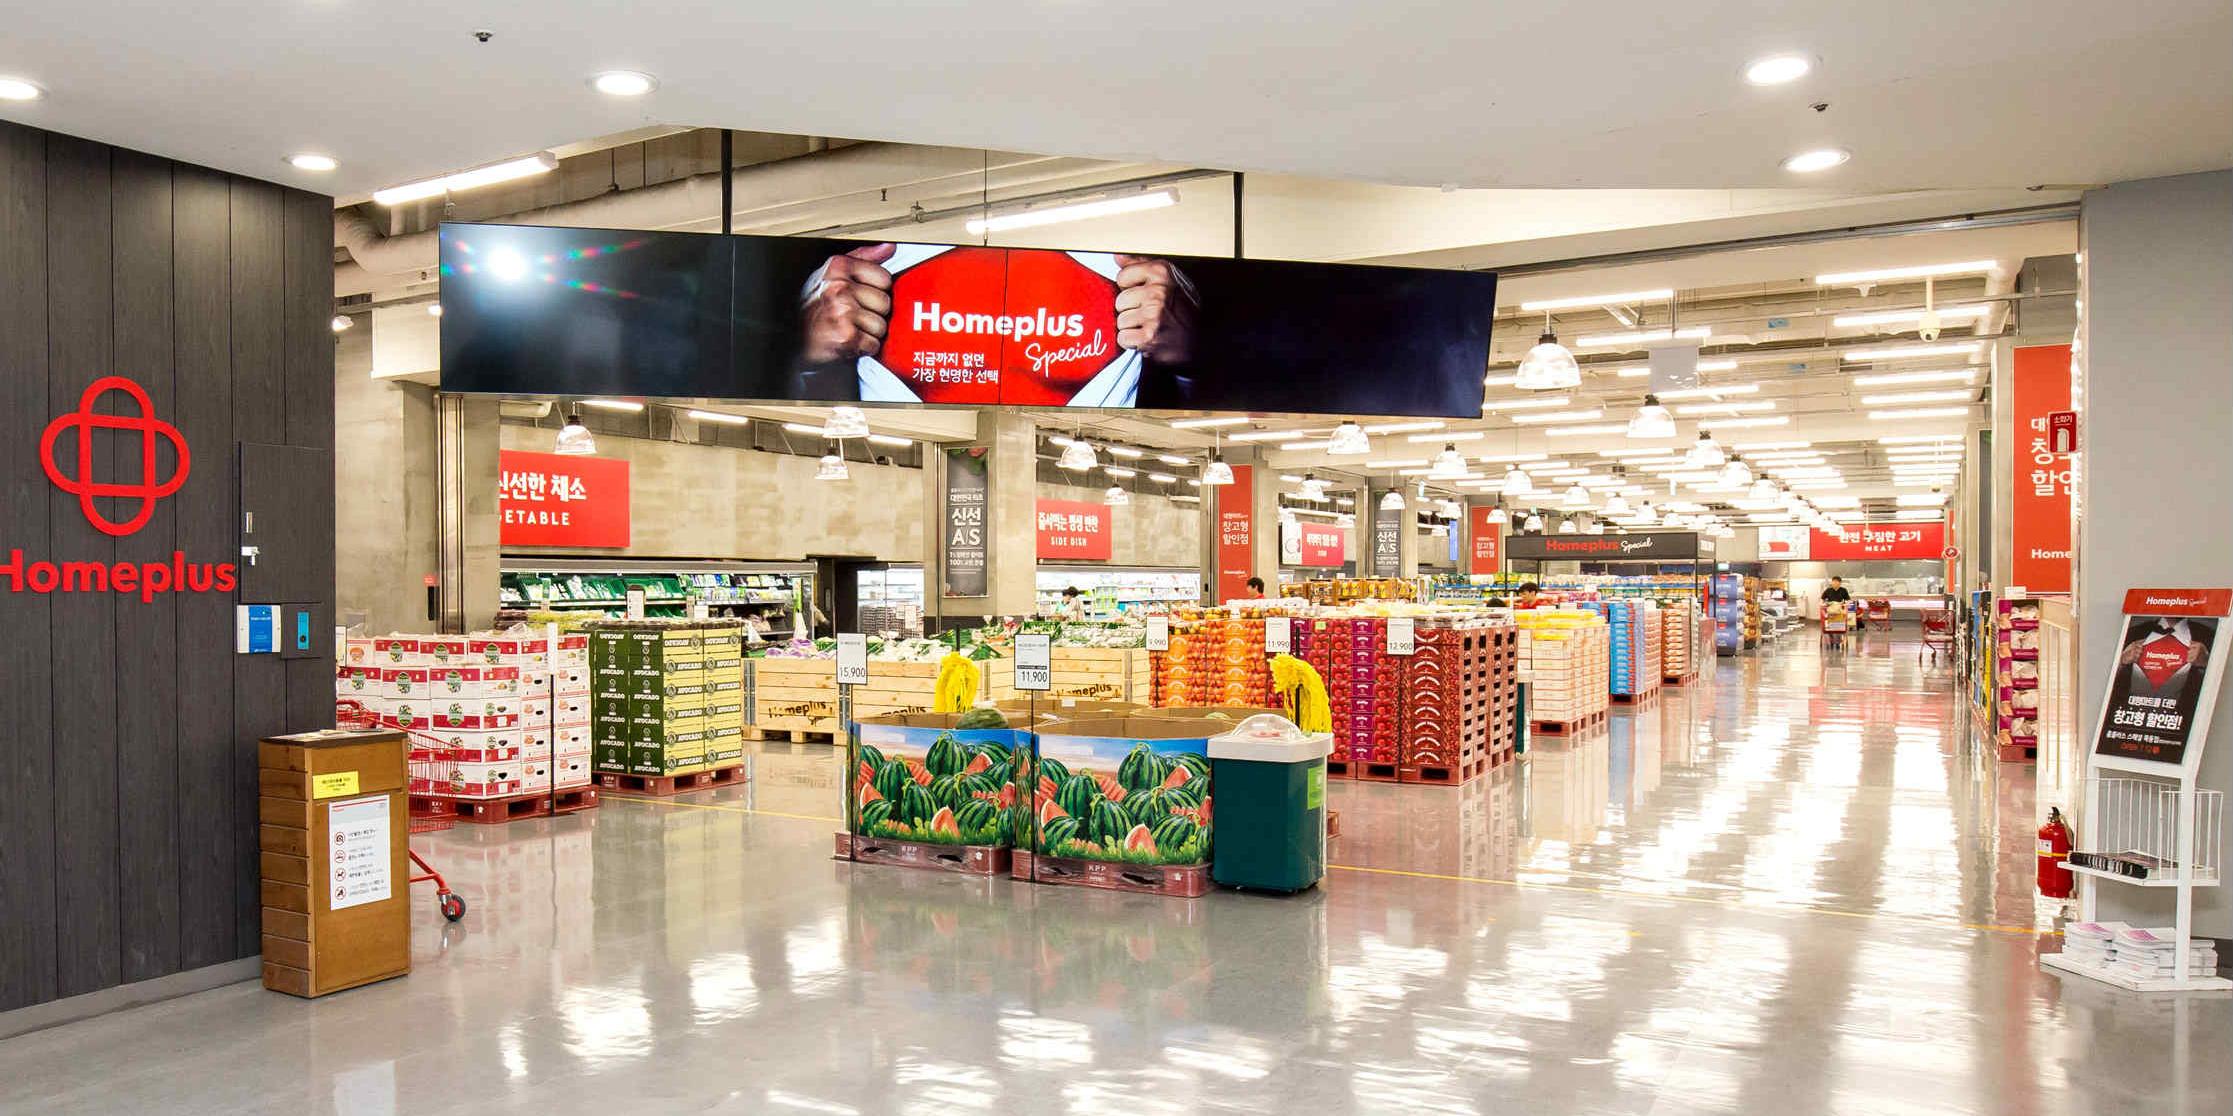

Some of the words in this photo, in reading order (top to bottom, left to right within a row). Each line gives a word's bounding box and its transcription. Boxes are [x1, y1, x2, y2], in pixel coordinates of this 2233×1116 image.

[913, 302, 1083, 342] Homeplus
[912, 351, 959, 367] 지금까지
[1026, 331, 1106, 375] Special
[912, 367, 936, 383] 가장
[938, 368, 973, 384] 현명한
[975, 370, 999, 384] 선택
[2030, 415, 2049, 432] 대
[498, 470, 546, 501] 신선한
[551, 474, 587, 502] 채소
[499, 509, 571, 526] ETABLE
[951, 506, 982, 527] 신선
[1223, 520, 1249, 533] 창고형
[951, 528, 982, 547] A/S
[1050, 536, 1067, 546] SIDE
[1070, 537, 1087, 547] DISH
[1222, 533, 1249, 546] 할인점
[1377, 531, 1397, 543] 신선
[1898, 529, 1921, 542] 고기
[1545, 538, 1620, 553] Homeplus
[1620, 536, 1653, 554] Special
[0, 549, 237, 603] Homeplus
[2145, 596, 2188, 607] Homeplus
[2145, 651, 2180, 661] Homeplus
[840, 667, 865, 678] 15,900
[1021, 670, 1048, 683] 11,900
[2113, 709, 2146, 727] 창고형
[2145, 712, 2183, 731] 할인점!
